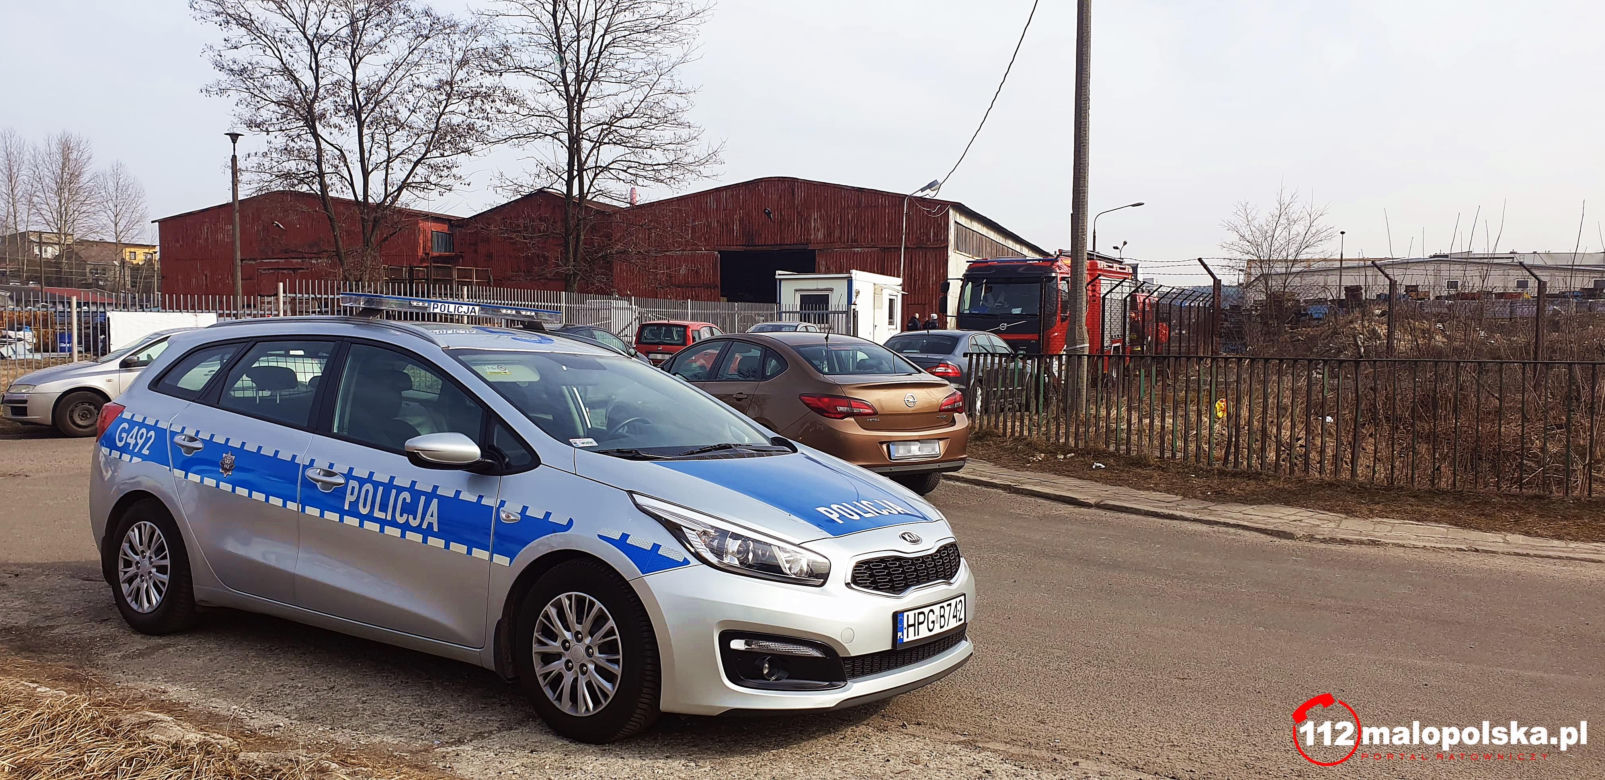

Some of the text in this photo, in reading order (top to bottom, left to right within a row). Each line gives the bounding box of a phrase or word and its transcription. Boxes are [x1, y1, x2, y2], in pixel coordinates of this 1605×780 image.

[432, 303, 477, 315] POLICJA
[115, 422, 156, 455] G492
[343, 479, 439, 532] POLICJA
[816, 499, 910, 524] POLICJA
[906, 599, 964, 639] HPG B742
